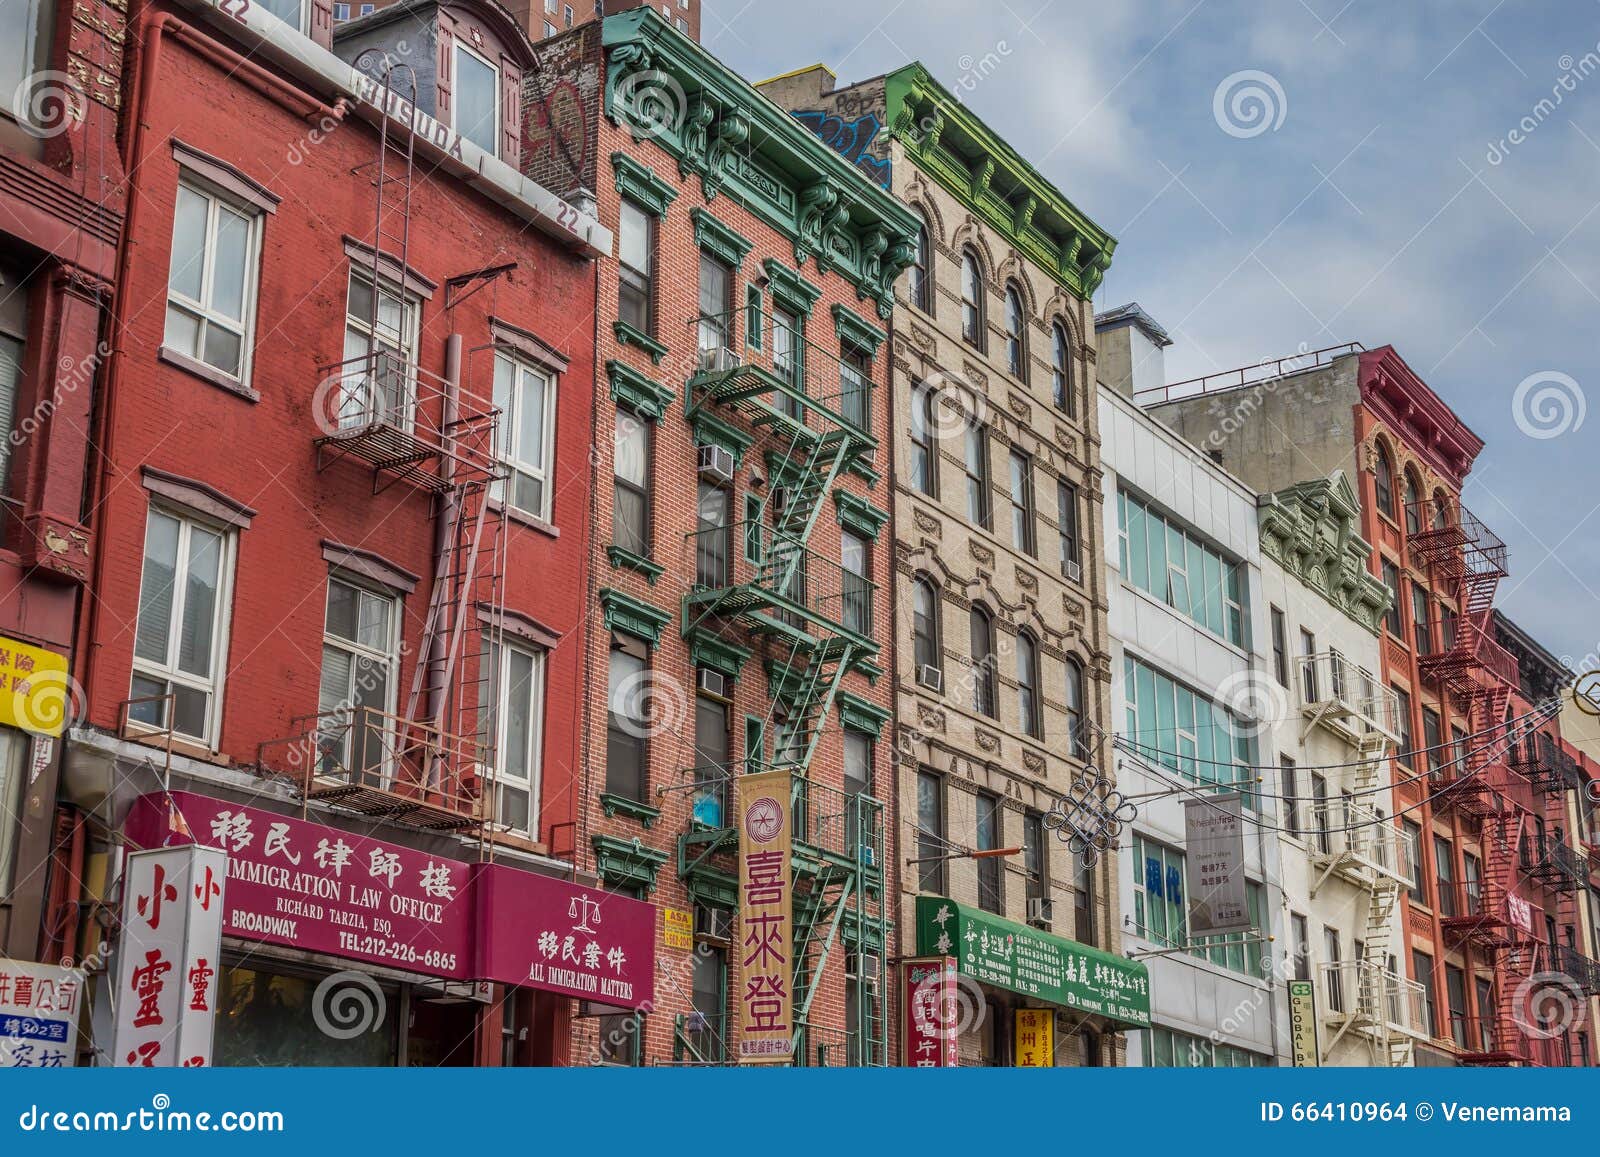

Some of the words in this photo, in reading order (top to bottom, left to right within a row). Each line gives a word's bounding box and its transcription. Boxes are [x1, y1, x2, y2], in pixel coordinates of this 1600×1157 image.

[556, 201, 578, 235] 22
[210, 810, 457, 901] 移民律師樓
[226, 857, 342, 901] IMMIGRATION
[350, 884, 382, 909] LAW
[390, 894, 443, 924] OFFICE
[232, 909, 297, 940] BROADWAY.
[276, 897, 323, 920] RICHARD
[330, 908, 368, 932] TARZIA,
[373, 917, 395, 938] ESQ.
[670, 911, 688, 923] ASA
[339, 931, 456, 971] TEL:212-226-6865
[537, 931, 627, 976] 移民案件
[743, 850, 788, 1033] 喜來登
[480, 982, 488, 994] 22
[529, 963, 545, 982] ALL
[548, 966, 598, 993] IMMIGRATION
[600, 976, 633, 1000] MATTERS
[1292, 997, 1303, 1050] GLOBAL
